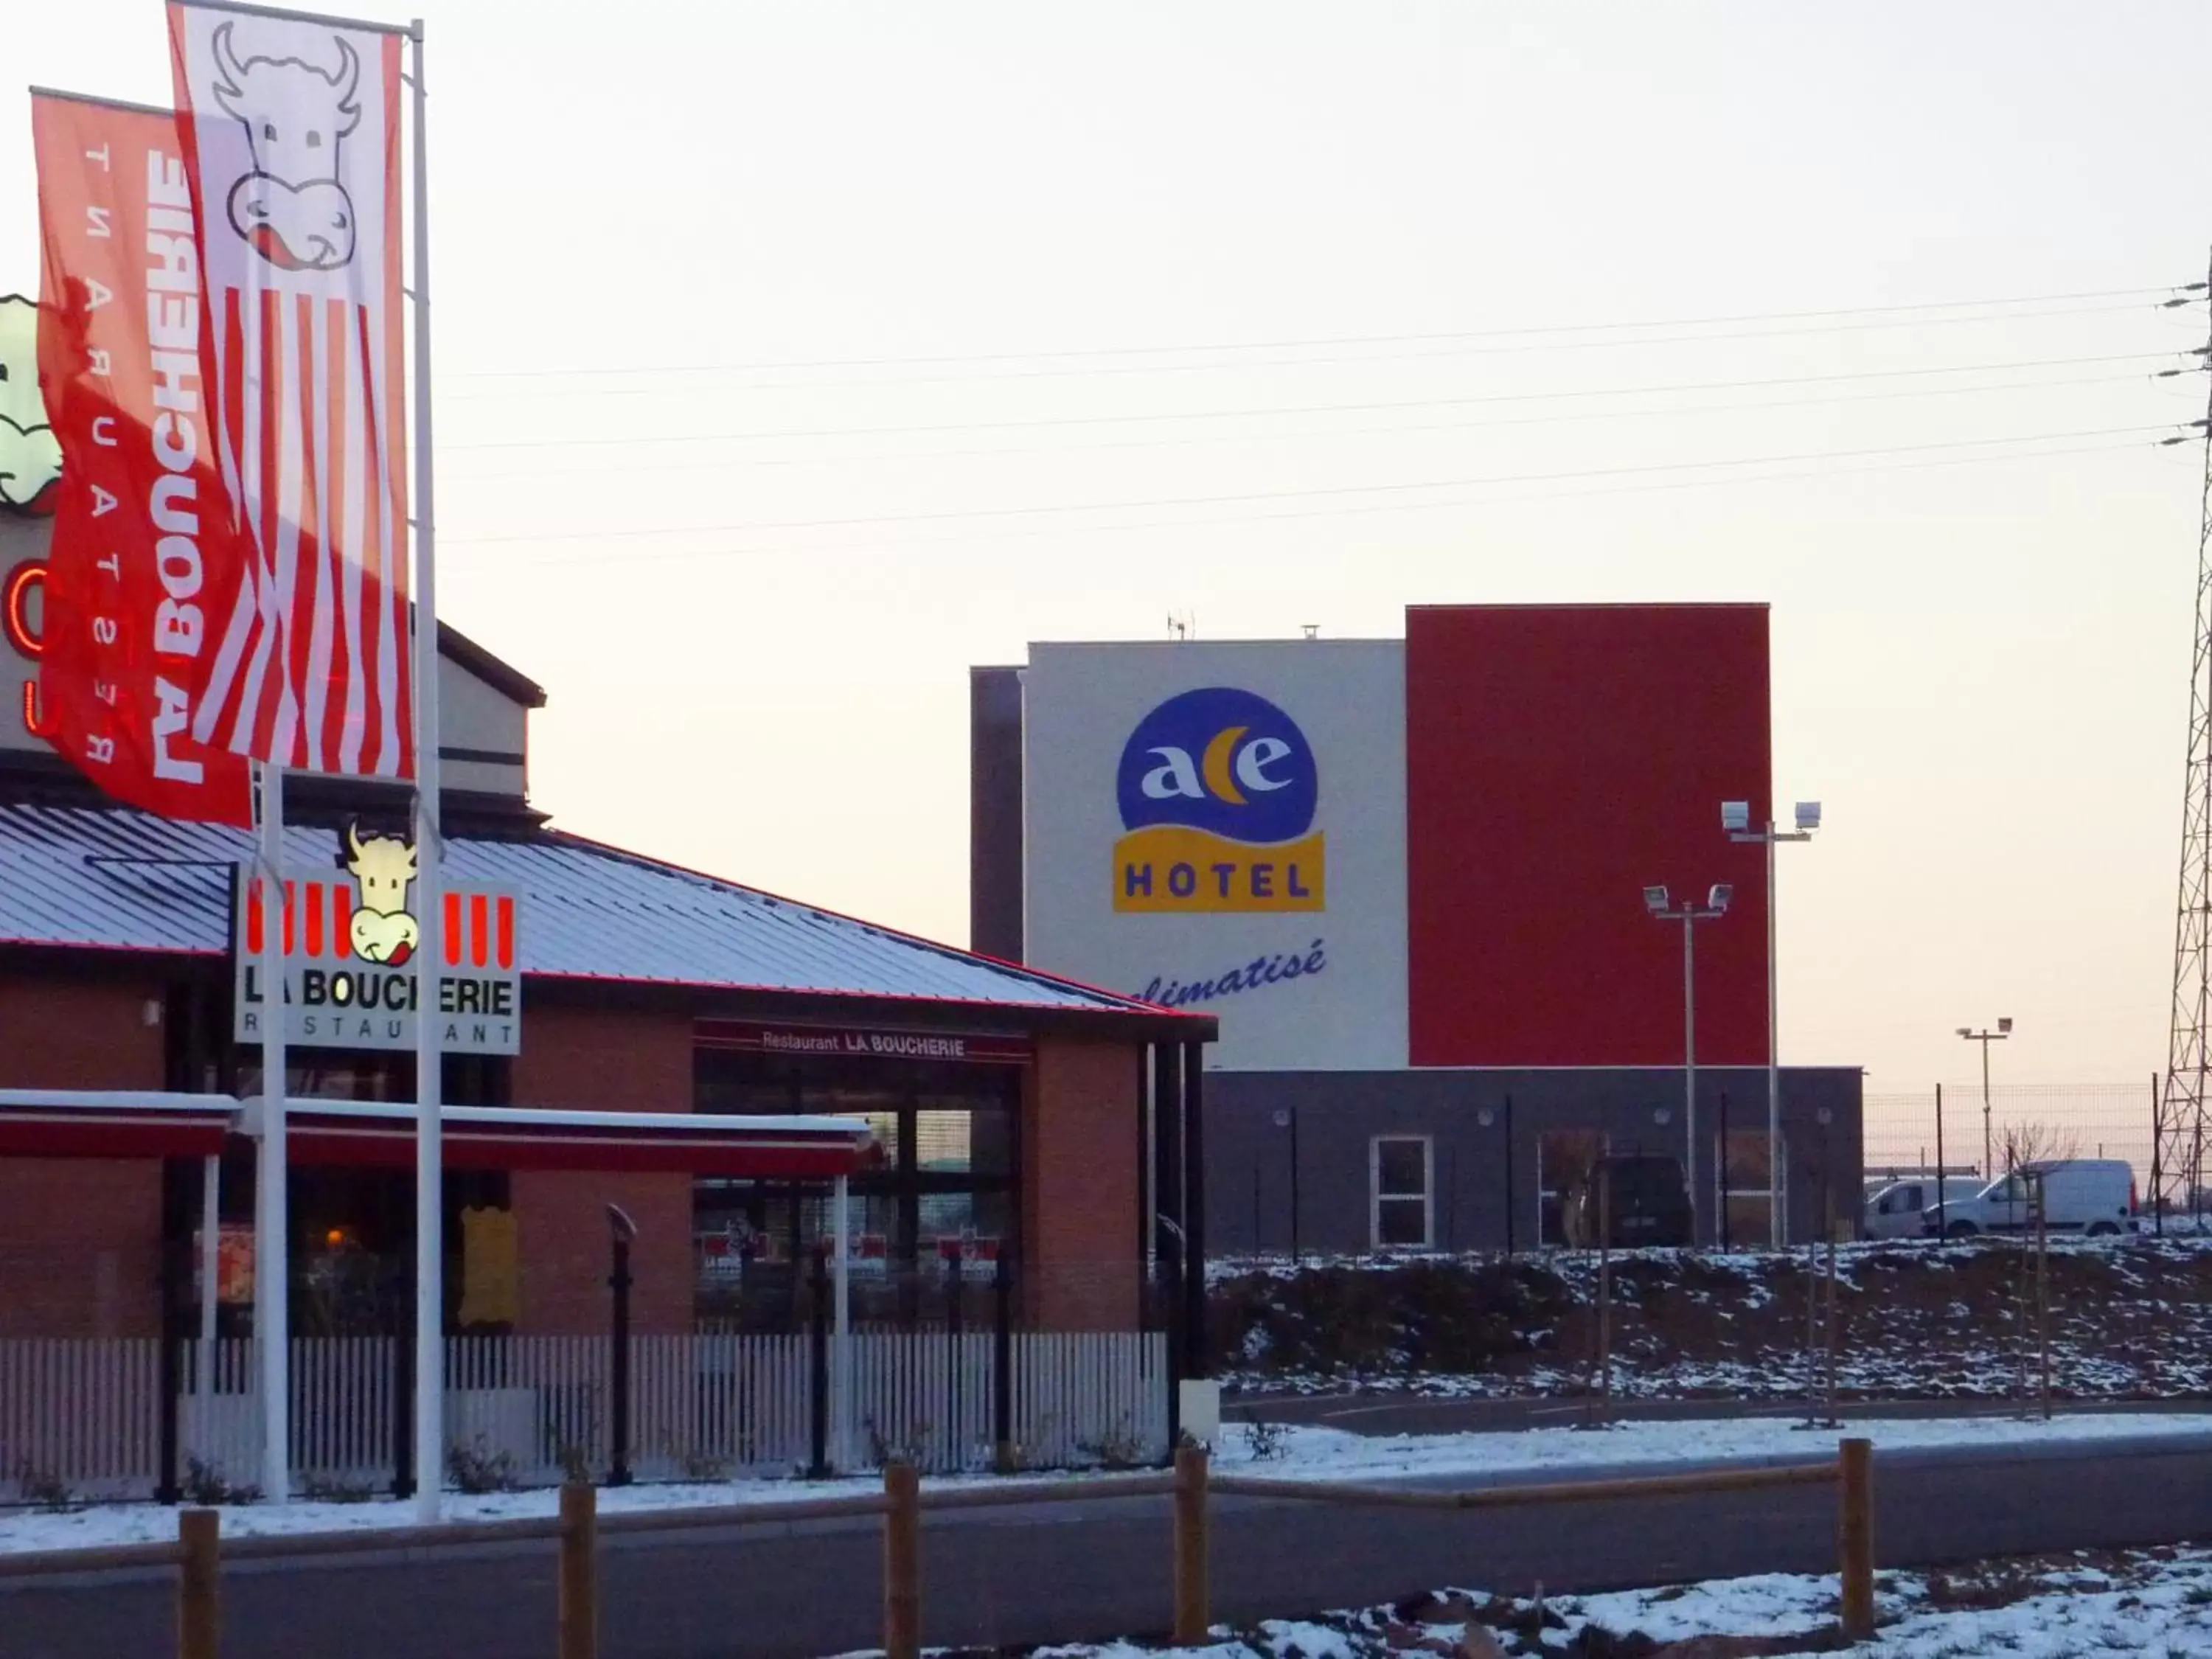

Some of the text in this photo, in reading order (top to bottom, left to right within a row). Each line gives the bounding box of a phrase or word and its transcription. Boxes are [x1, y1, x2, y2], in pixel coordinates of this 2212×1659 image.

[1125, 862, 1310, 897] HOTEL
[244, 965, 291, 1004] L
[1132, 938, 1326, 1007] limatisé
[245, 1012, 513, 1044] RSTAUANT
[762, 1032, 964, 1057] Restaurant LA BOUCHERIE
